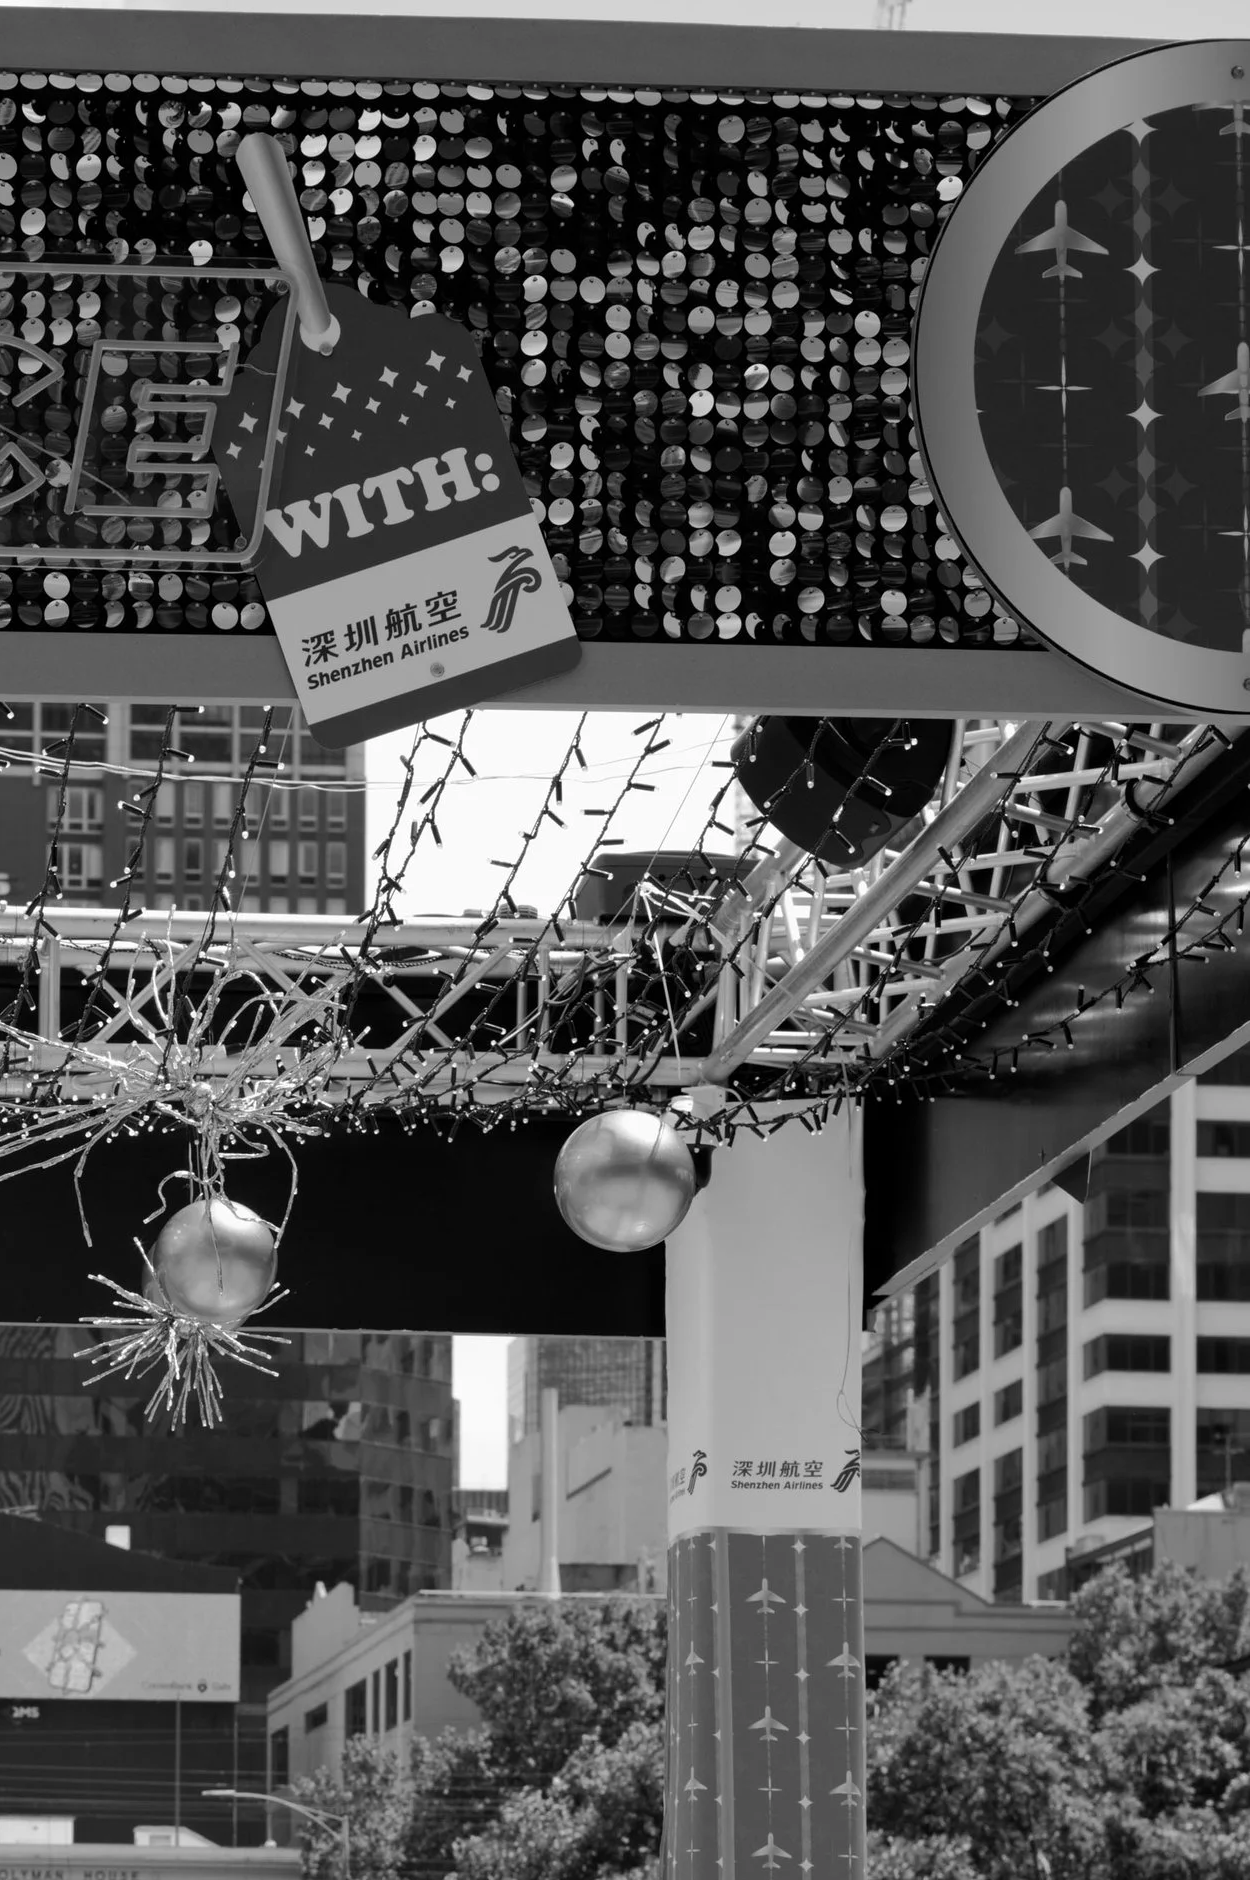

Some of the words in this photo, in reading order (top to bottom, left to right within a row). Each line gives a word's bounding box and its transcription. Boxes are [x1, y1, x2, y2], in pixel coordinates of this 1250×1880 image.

[263, 446, 500, 558] WITH:
[301, 590, 462, 667] 深圳航空
[307, 648, 395, 690] Shenzhen
[400, 625, 470, 660] Airlines
[730, 1480, 781, 1490] Shenzhen
[783, 1480, 824, 1490] Airlines
[732, 1460, 824, 1478] 深圳航空
